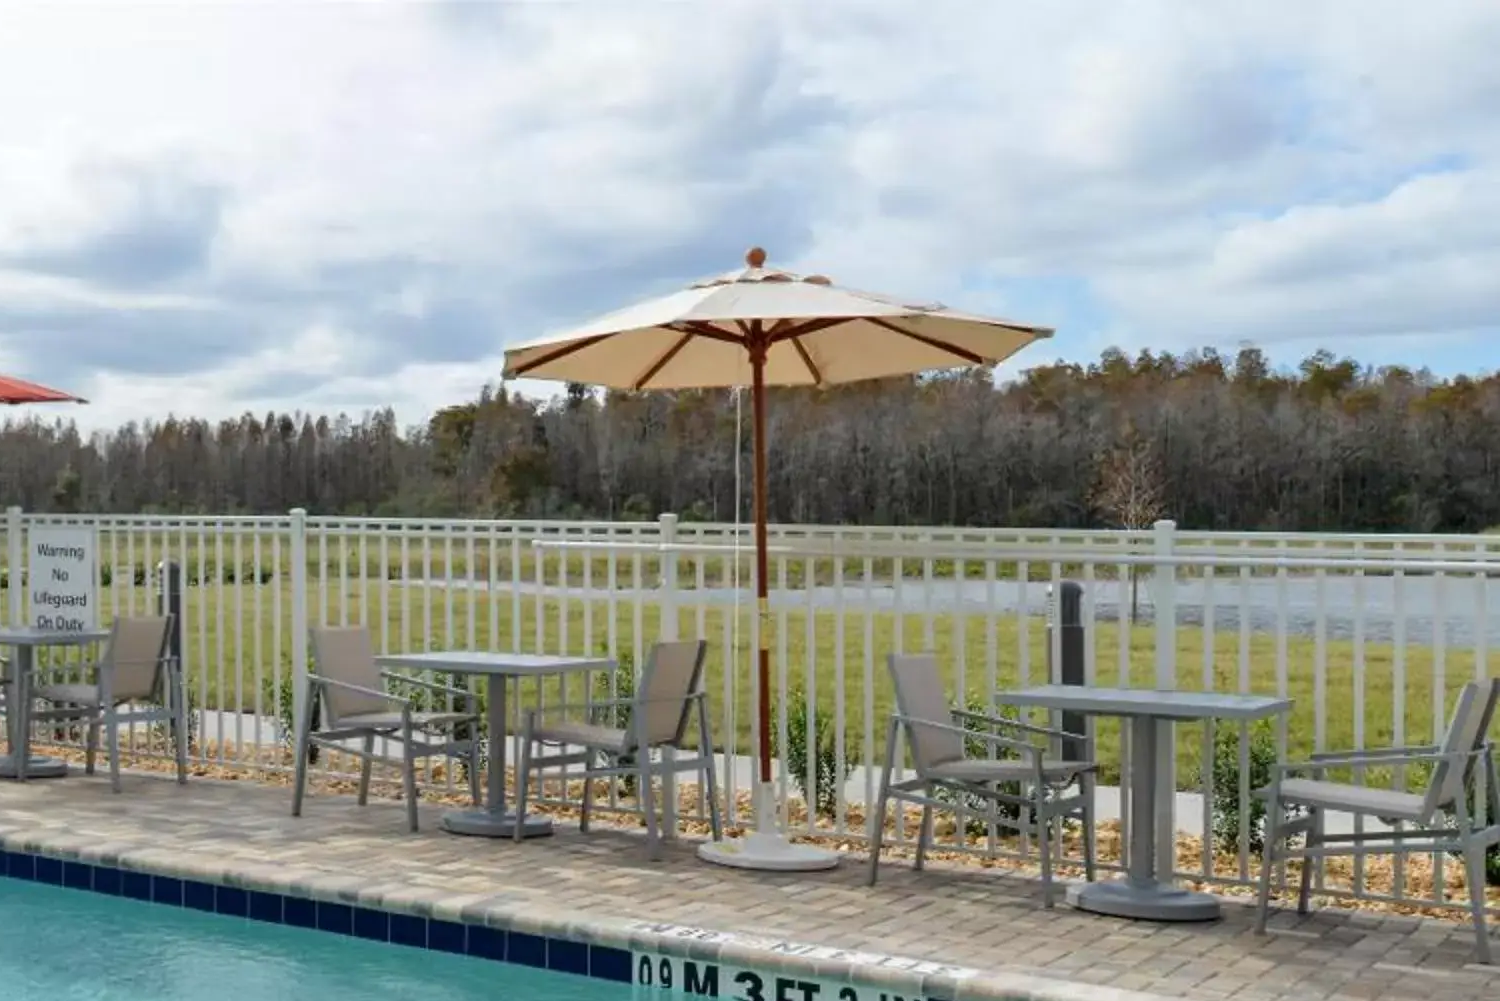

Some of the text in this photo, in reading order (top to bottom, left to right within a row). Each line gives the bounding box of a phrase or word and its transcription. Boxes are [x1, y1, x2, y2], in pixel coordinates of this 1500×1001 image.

[37, 544, 84, 561] Warning
[52, 568, 69, 582] No
[33, 591, 87, 608] Lifeguard
[37, 615, 84, 631] On Duty
[684, 961, 719, 997] M
